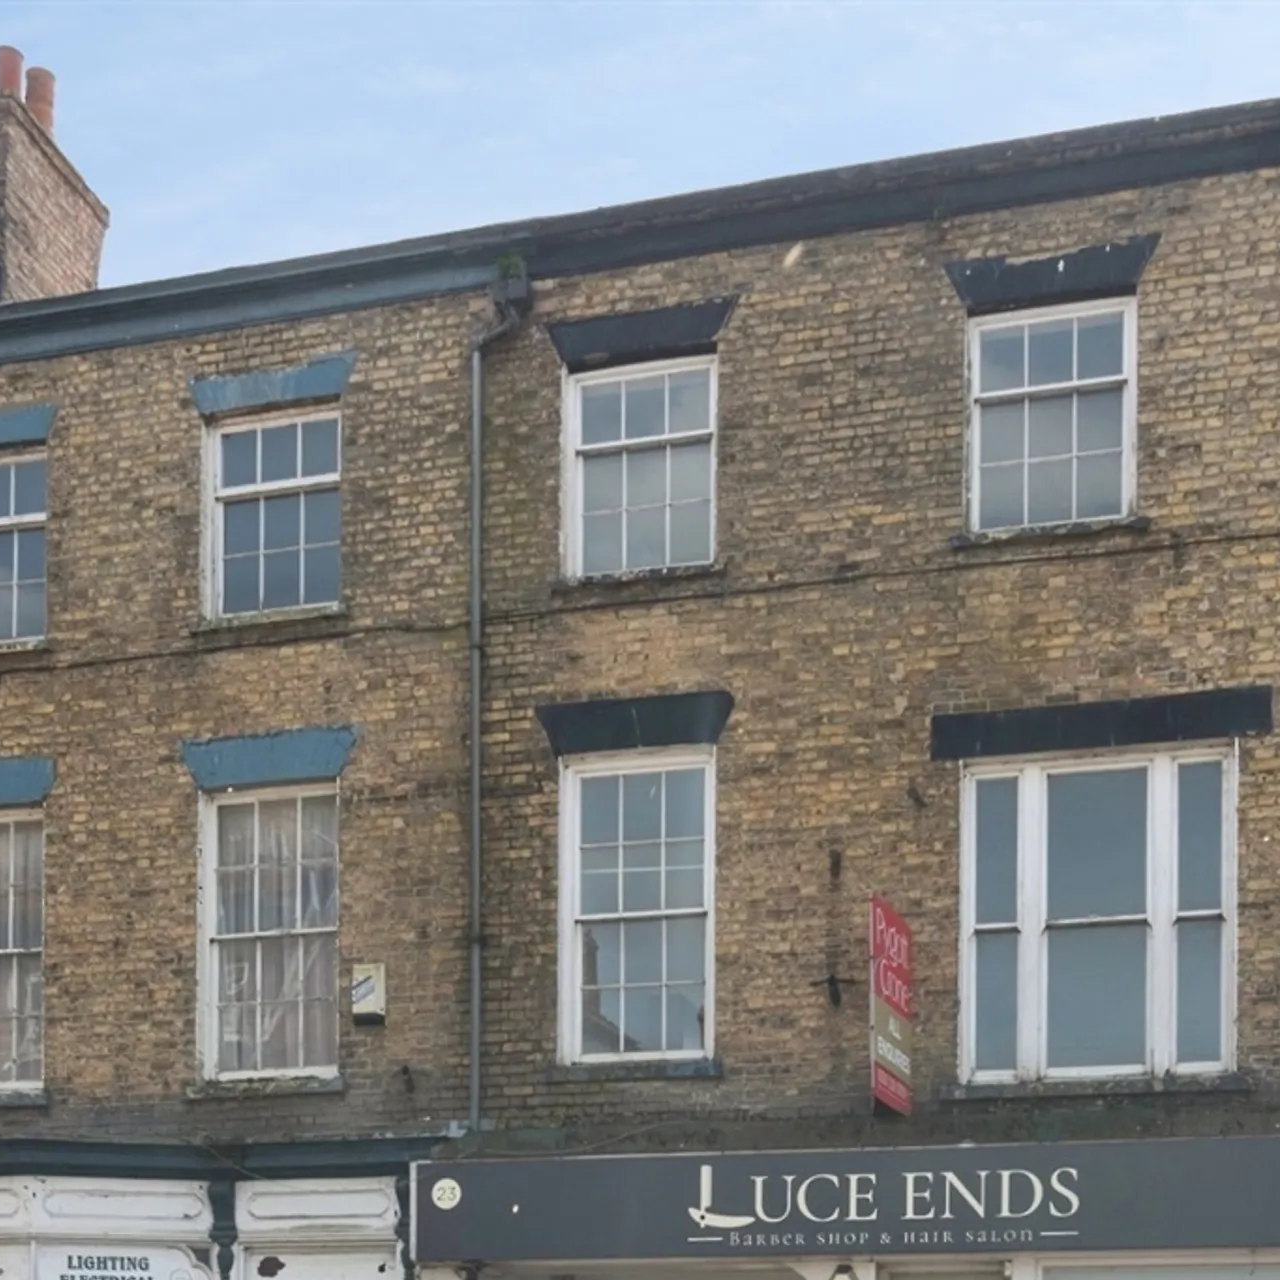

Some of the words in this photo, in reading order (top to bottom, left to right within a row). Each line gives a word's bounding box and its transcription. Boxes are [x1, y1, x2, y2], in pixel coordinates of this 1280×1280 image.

[436, 1186, 458, 1202] 23
[688, 1164, 878, 1230] LUCE
[901, 1167, 1081, 1221] ENDS
[879, 1231, 892, 1245] &
[66, 1255, 150, 1271] LIGHTING
